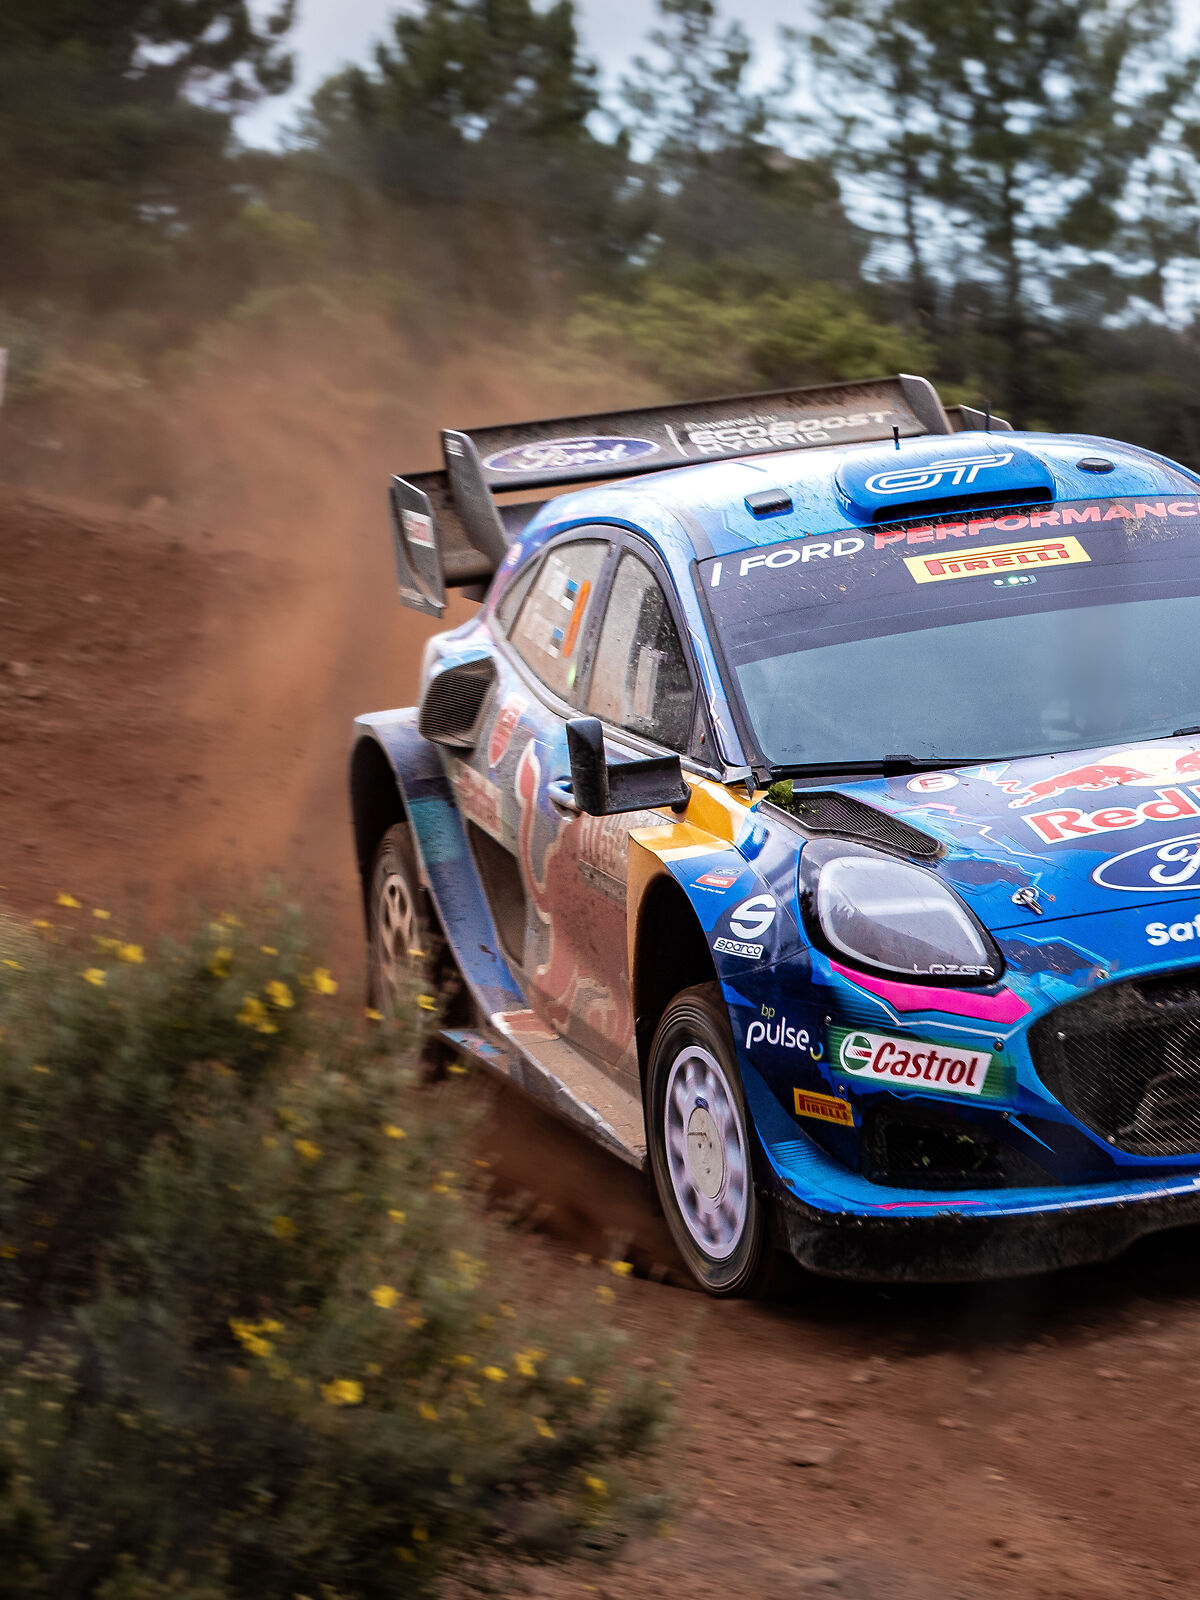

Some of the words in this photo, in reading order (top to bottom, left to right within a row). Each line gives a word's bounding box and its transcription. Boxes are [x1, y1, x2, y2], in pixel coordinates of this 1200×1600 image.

[688, 411, 893, 446] ECOBOOST
[697, 430, 832, 455] HYBRID
[509, 441, 630, 471] Ford
[739, 537, 865, 577] FORD
[923, 543, 1071, 576] PIRELLI
[1028, 786, 1198, 842] Red
[717, 939, 762, 956] sparco
[761, 1003, 776, 1020] bp
[745, 1016, 810, 1052] pulse
[872, 1041, 976, 1087] Castrol
[799, 1092, 849, 1121] PIRELLI
